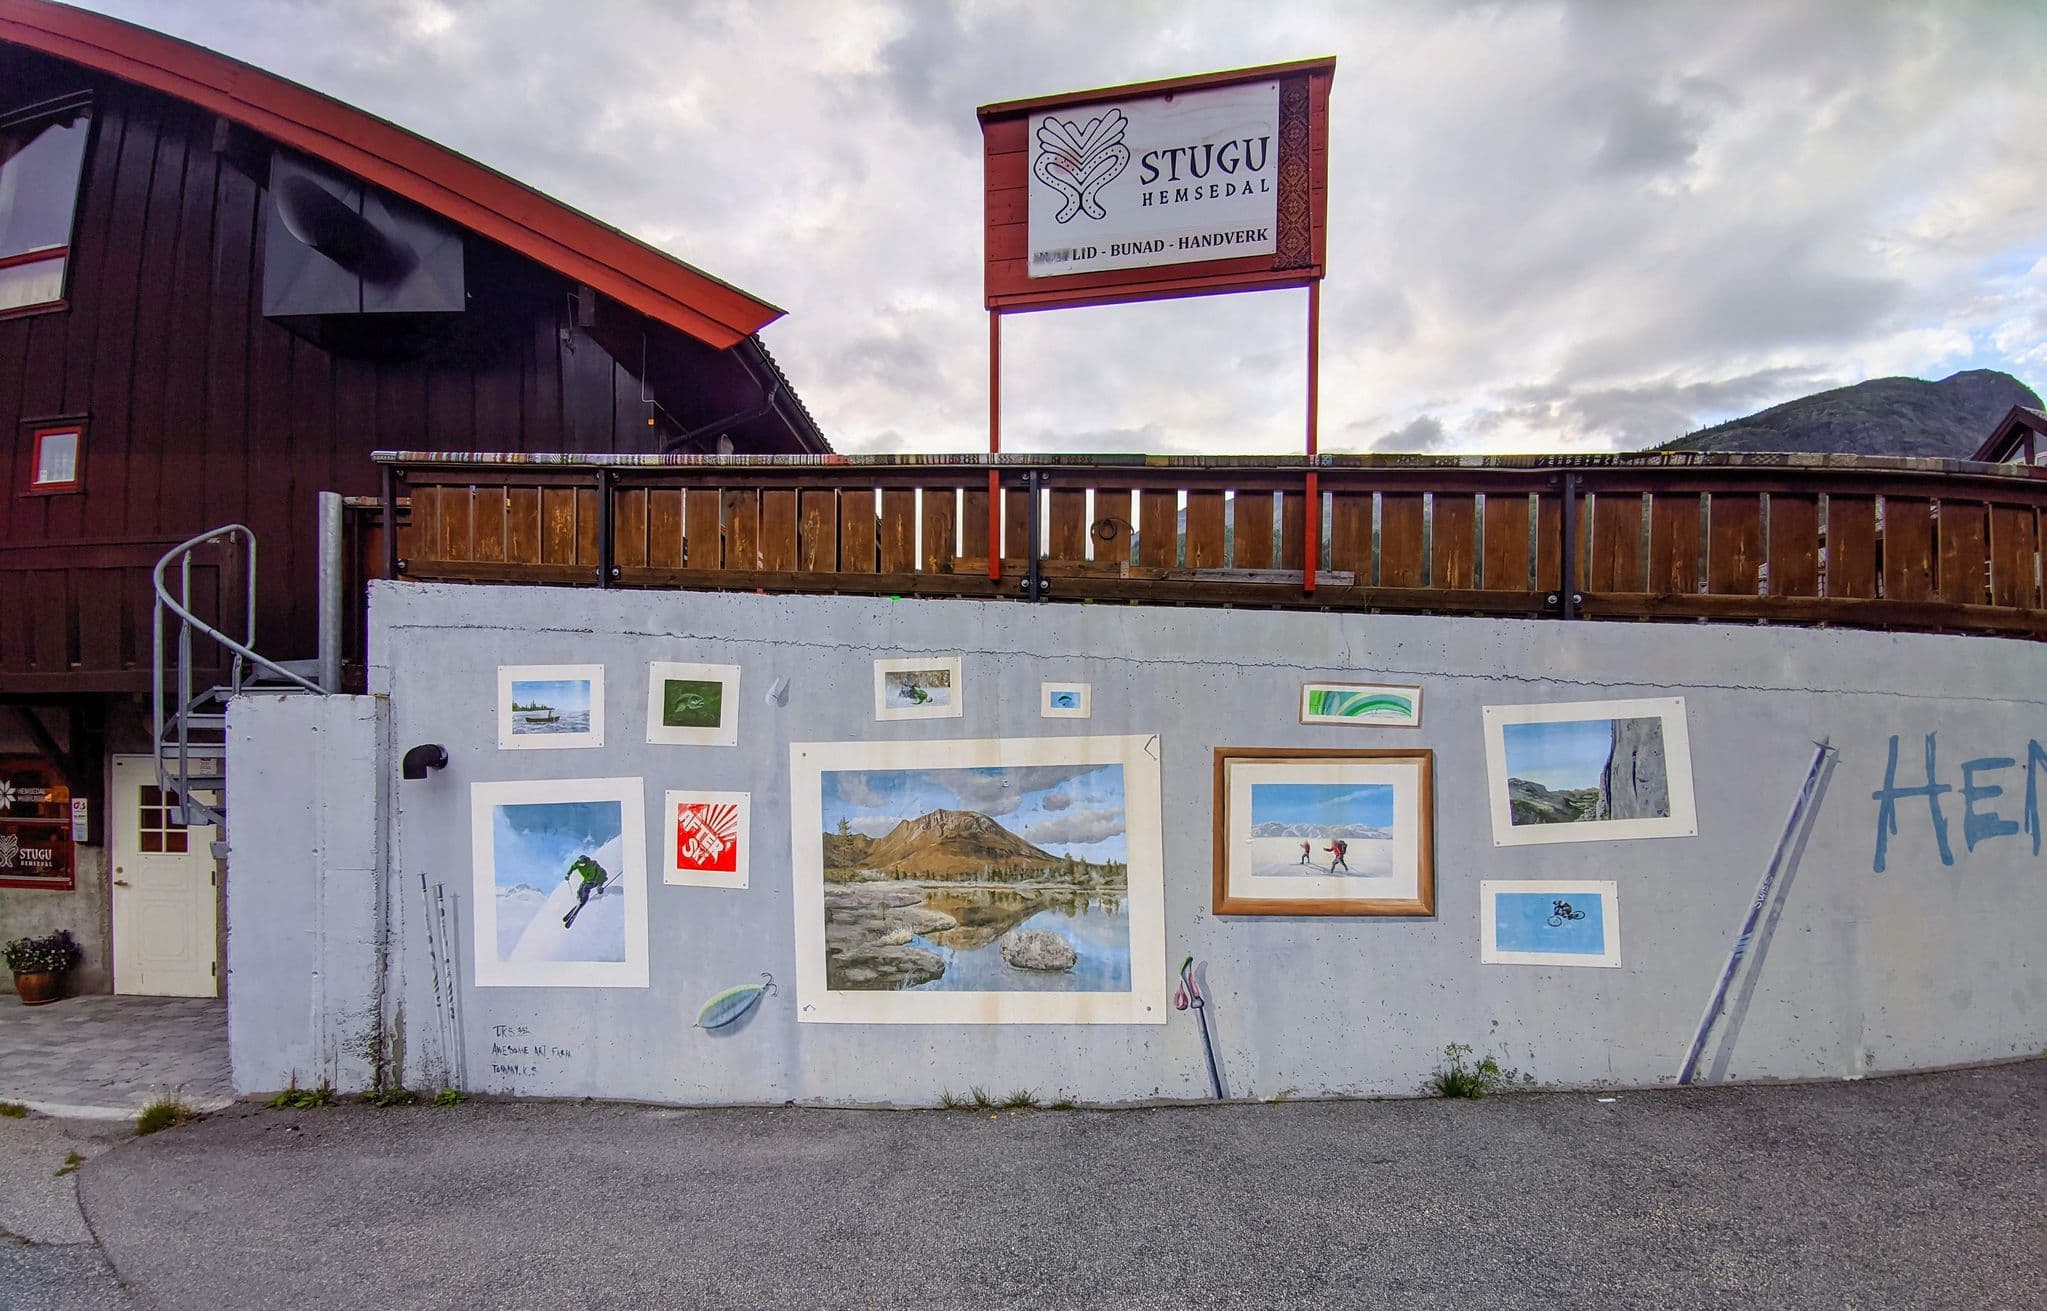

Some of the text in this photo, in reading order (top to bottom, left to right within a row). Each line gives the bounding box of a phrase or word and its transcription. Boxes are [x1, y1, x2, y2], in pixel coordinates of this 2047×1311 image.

[1140, 136, 1270, 185] STUGU
[1142, 178, 1270, 207] HEMSEDAL
[1110, 239, 1165, 257] BUNAD
[1178, 228, 1268, 250] HANDVERK
[678, 809, 725, 865] AFTER
[20, 848, 52, 860] STUGU
